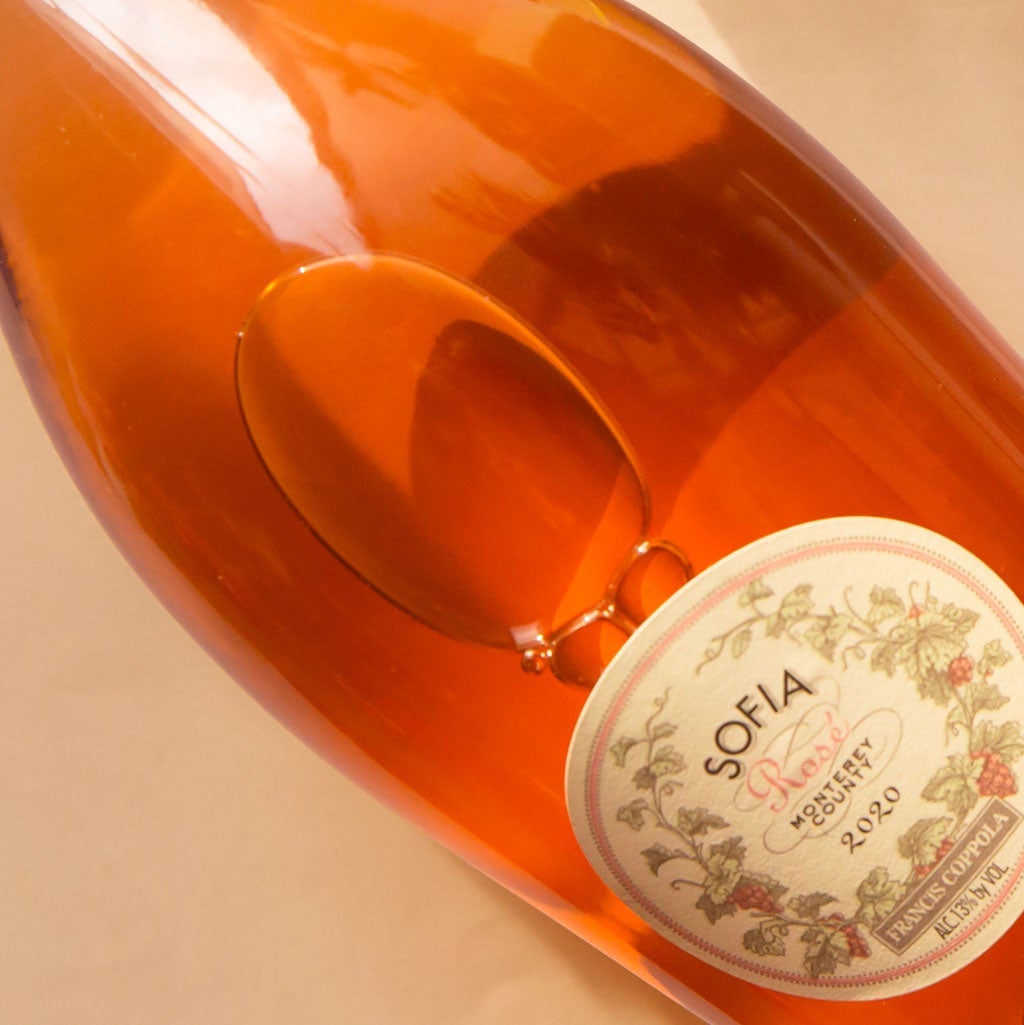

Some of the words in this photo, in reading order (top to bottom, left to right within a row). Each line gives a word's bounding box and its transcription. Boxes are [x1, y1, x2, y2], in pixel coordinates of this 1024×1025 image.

[703, 669, 815, 781] SOFIA
[746, 710, 850, 814] Rosé
[789, 736, 874, 830] MONTEREY
[811, 757, 874, 827] COUNTY
[840, 786, 901, 855] 2020
[885, 882, 947, 943] FRANCIS
[941, 812, 1010, 887] COPPOLA
[951, 894, 979, 921] 13%
[968, 883, 992, 900] by
